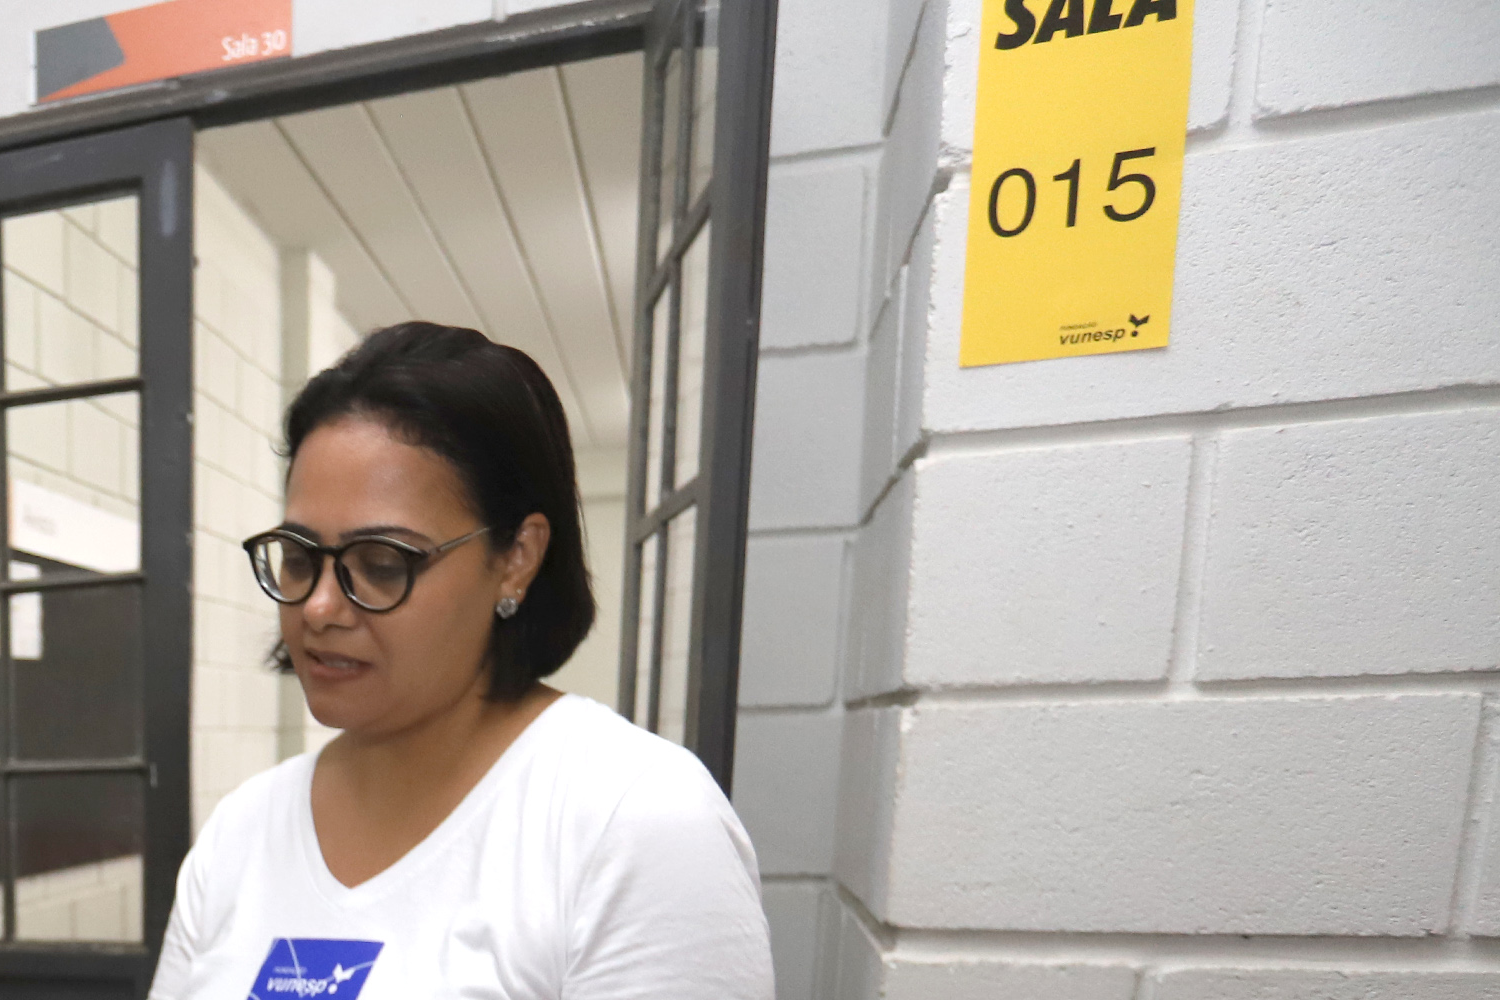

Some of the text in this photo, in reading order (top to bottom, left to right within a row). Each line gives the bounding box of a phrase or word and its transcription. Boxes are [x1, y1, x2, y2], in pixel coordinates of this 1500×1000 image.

[221, 30, 287, 60] Sala 30
[987, 146, 1157, 238] 015
[1059, 329, 1126, 345] vunesp
[266, 976, 328, 997] vunesp
